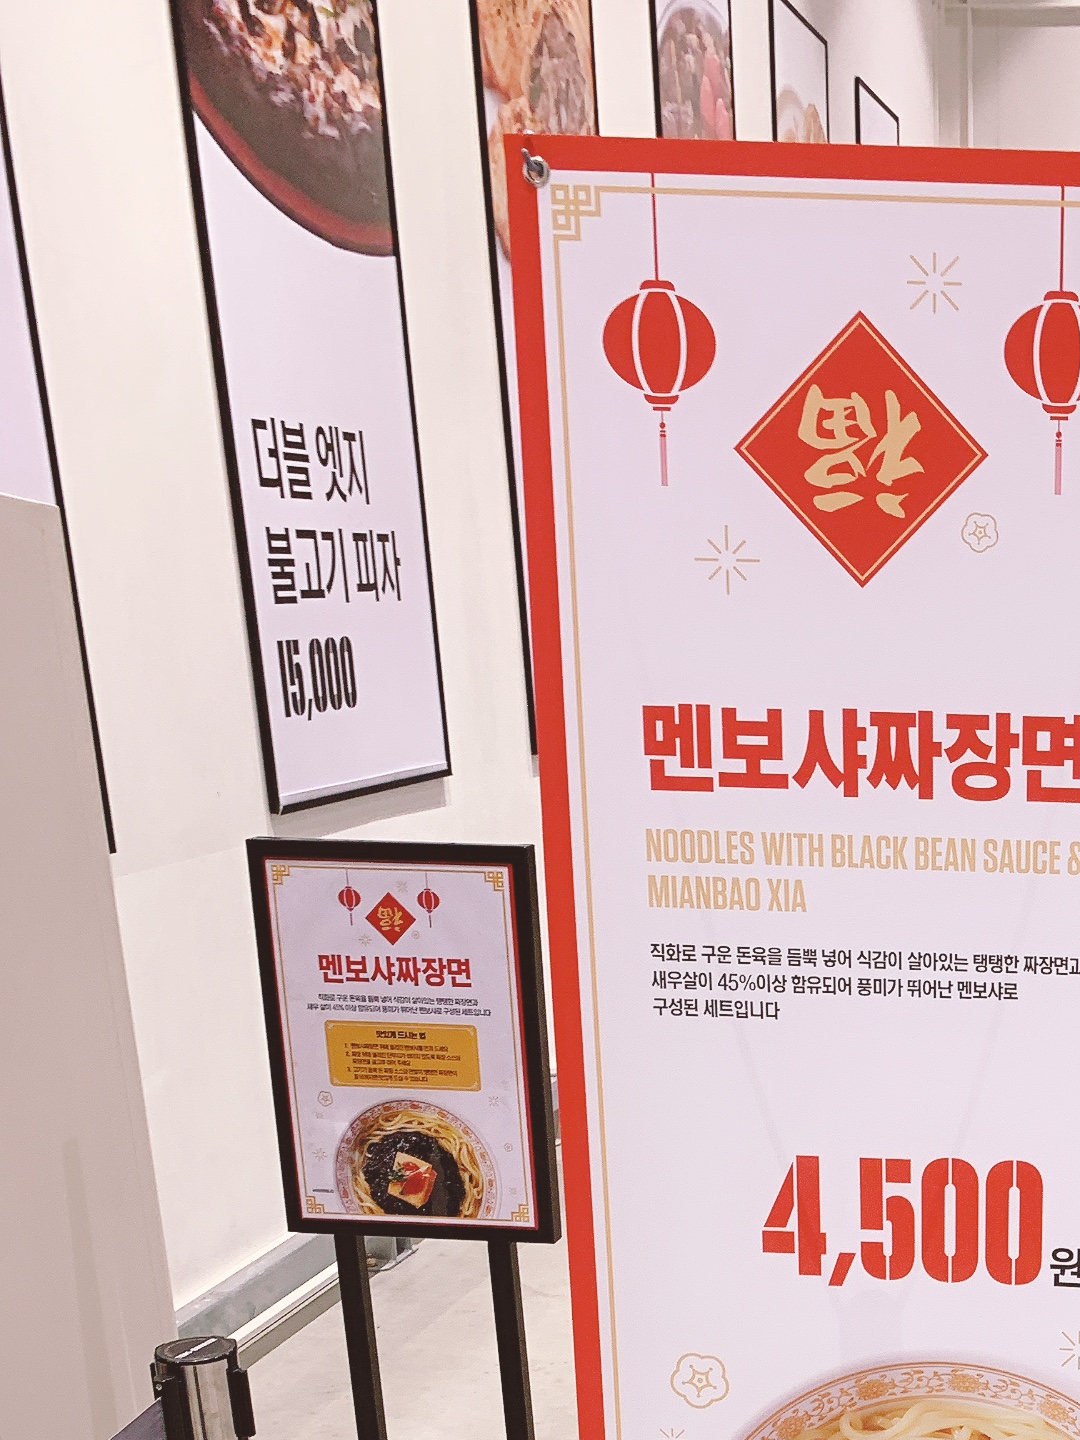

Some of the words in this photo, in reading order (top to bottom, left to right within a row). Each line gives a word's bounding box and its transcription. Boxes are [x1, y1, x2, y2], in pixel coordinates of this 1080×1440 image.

[251, 417, 313, 500] 더블
[315, 425, 370, 505] 엣지
[265, 527, 350, 605] 불고기
[352, 529, 402, 602] 피자
[277, 636, 357, 721] 15,000
[646, 828, 755, 866] NOODLES
[761, 832, 825, 868] WITH
[831, 834, 908, 871] BLACK
[915, 836, 976, 873] BEAN
[983, 838, 1061, 876] SAUCE
[648, 875, 761, 911] MIANBAO
[768, 879, 807, 912] XIA
[317, 954, 473, 988] 멘보샤짜장면
[650, 943, 697, 962] 직화로
[701, 945, 732, 964] 구운
[736, 946, 782, 966] 돈육을
[787, 948, 817, 968] 듬뿍
[822, 949, 852, 969] 넣어
[857, 950, 903, 970] 식감이
[907, 951, 969, 972] 살아있는
[973, 953, 1020, 974] 탱탱한
[652, 970, 713, 991] 새우살이
[718, 973, 788, 993] 45%이상
[791, 975, 852, 996] 함유되어
[857, 977, 904, 998] 풍미가
[907, 979, 953, 999] 뛰어난
[957, 981, 1019, 1001] 멘보샤로
[653, 998, 699, 1017] 구성된
[703, 999, 780, 1020] 세트입니다
